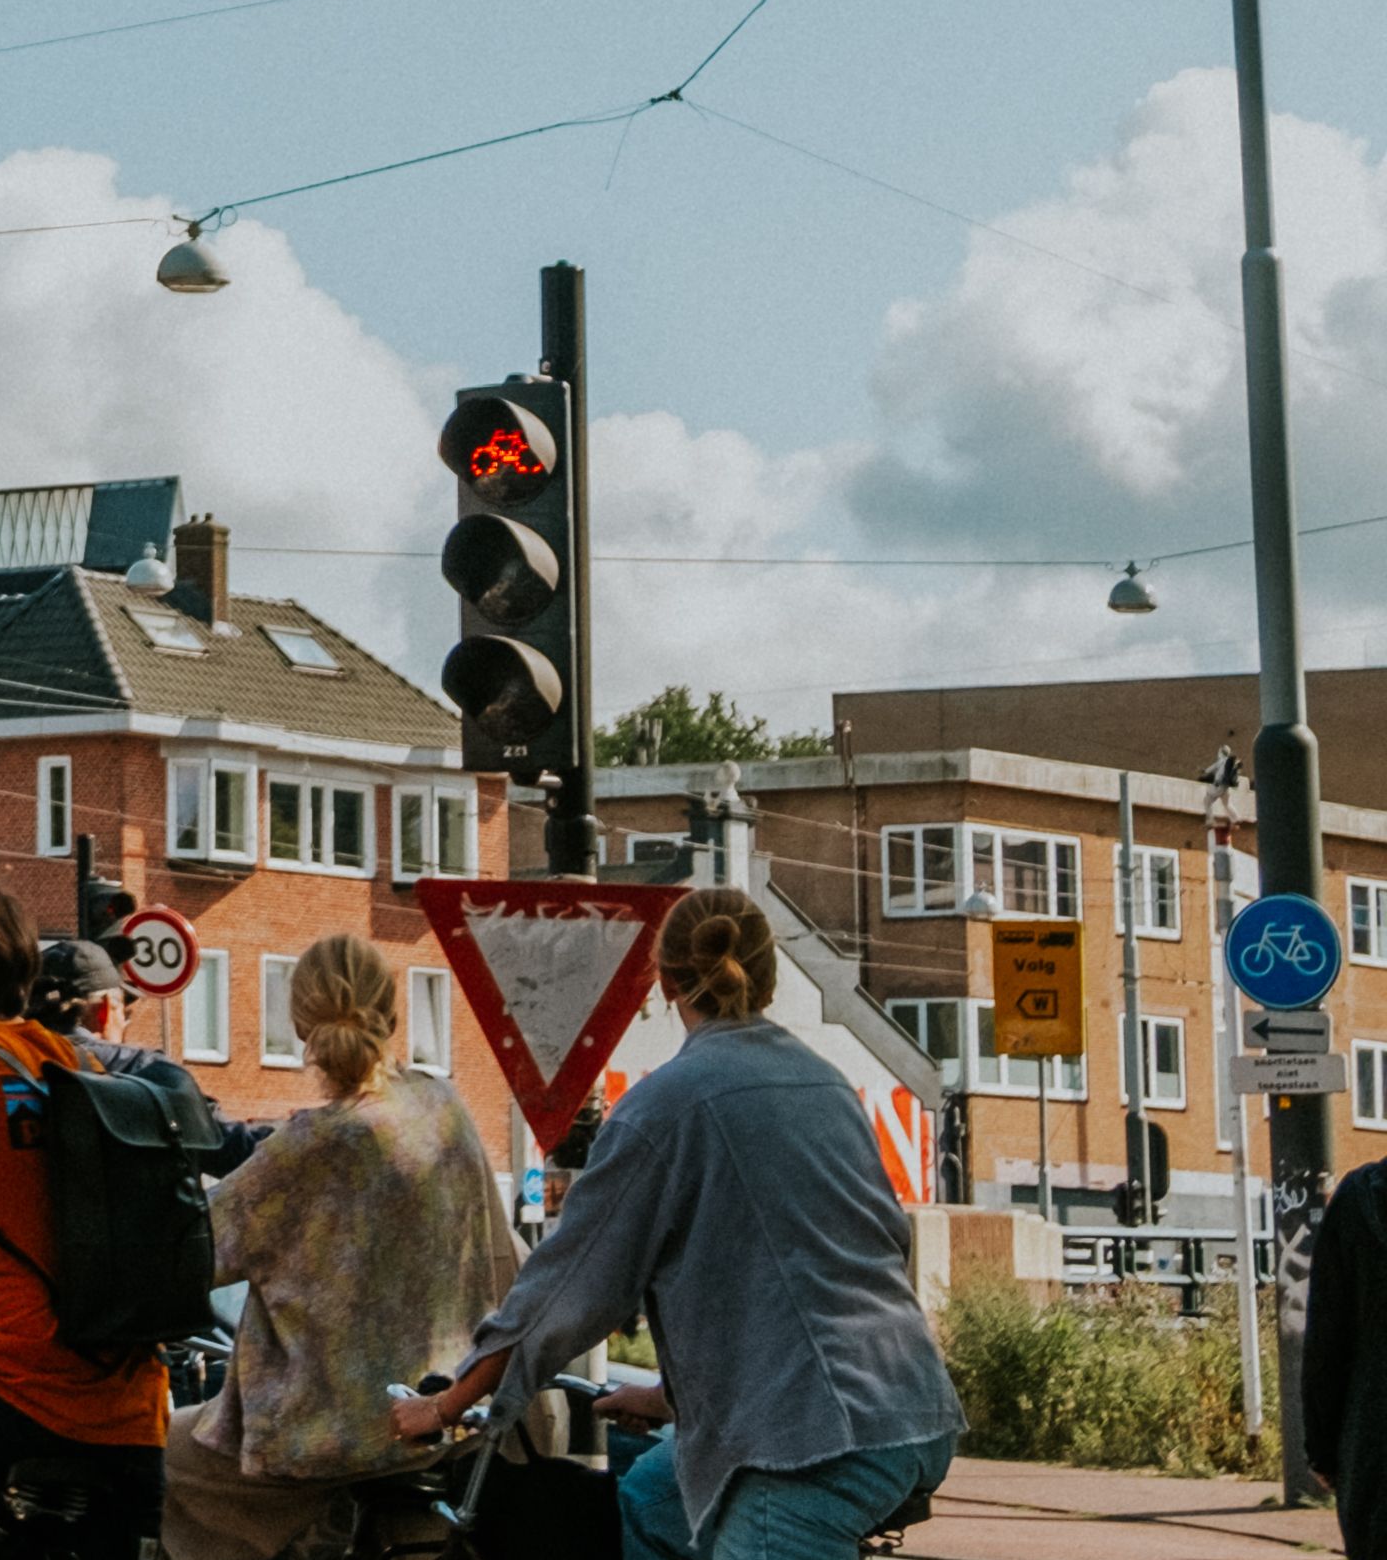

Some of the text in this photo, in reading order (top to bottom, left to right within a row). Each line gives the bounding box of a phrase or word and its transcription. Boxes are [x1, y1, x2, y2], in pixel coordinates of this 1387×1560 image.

[132, 935, 183, 969] 30
[1013, 958, 1056, 975] Volg
[1032, 996, 1048, 1010] W
